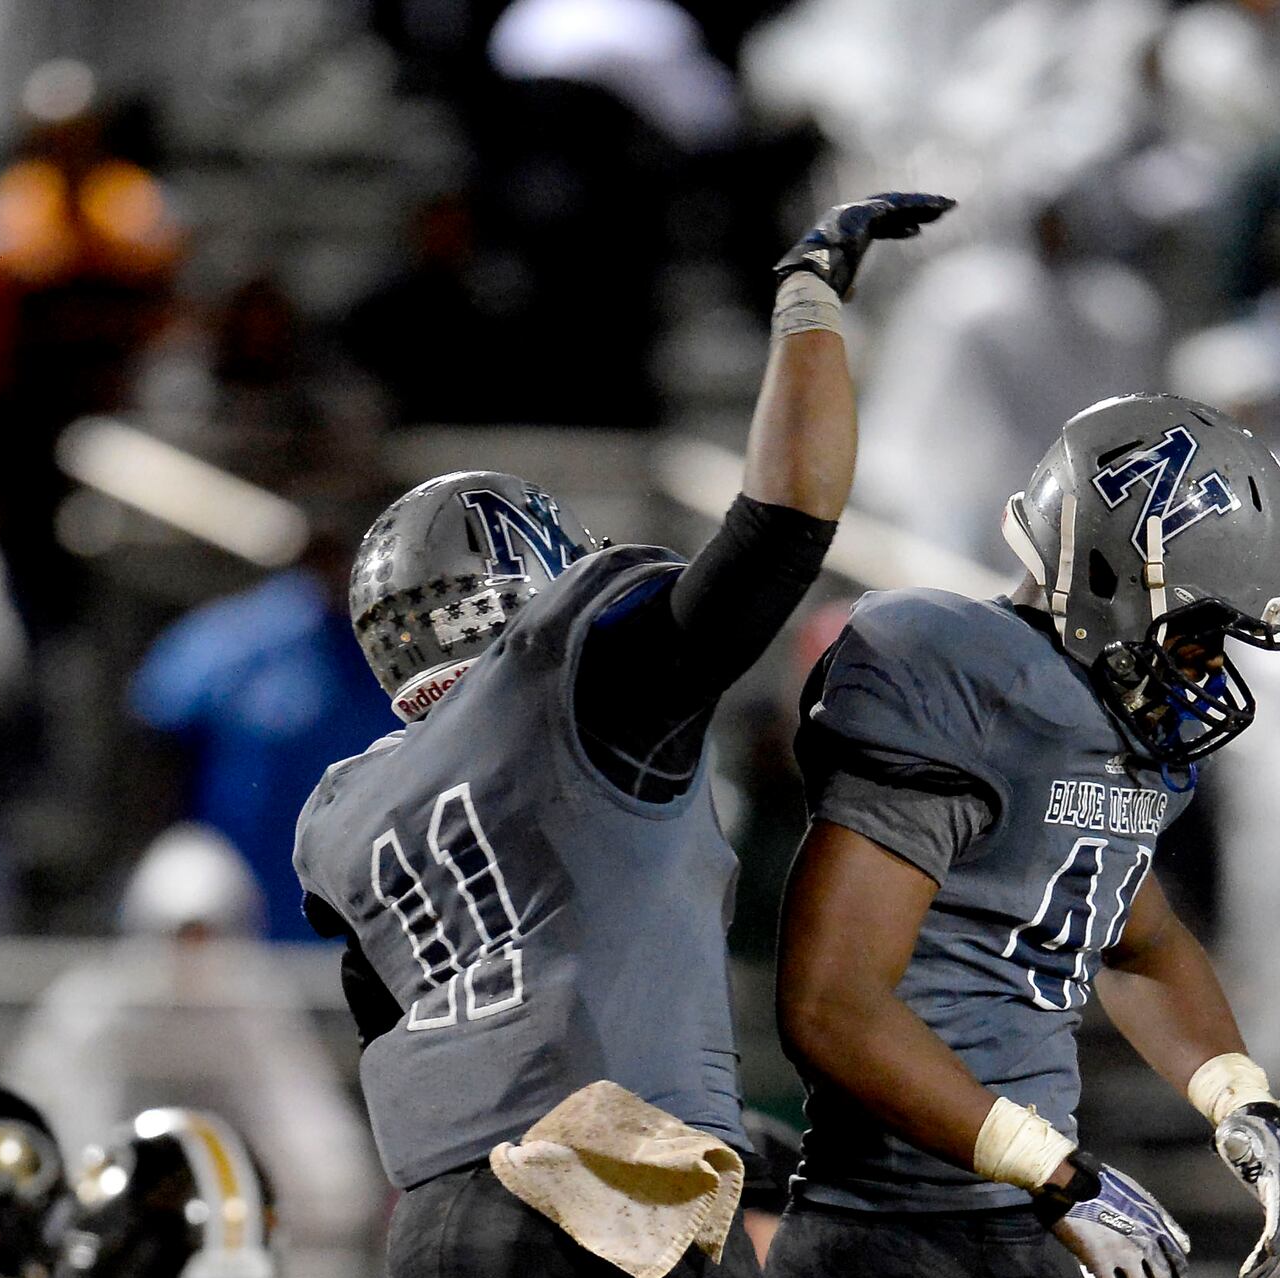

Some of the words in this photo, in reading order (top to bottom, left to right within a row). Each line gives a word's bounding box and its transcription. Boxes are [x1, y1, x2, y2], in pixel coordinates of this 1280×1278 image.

[461, 489, 590, 581] N
[1090, 425, 1238, 563] N
[397, 666, 470, 716] Ridde
[1044, 780, 1105, 830] BLUE
[1109, 787, 1168, 836] DEVILS
[371, 782, 523, 1032] 11
